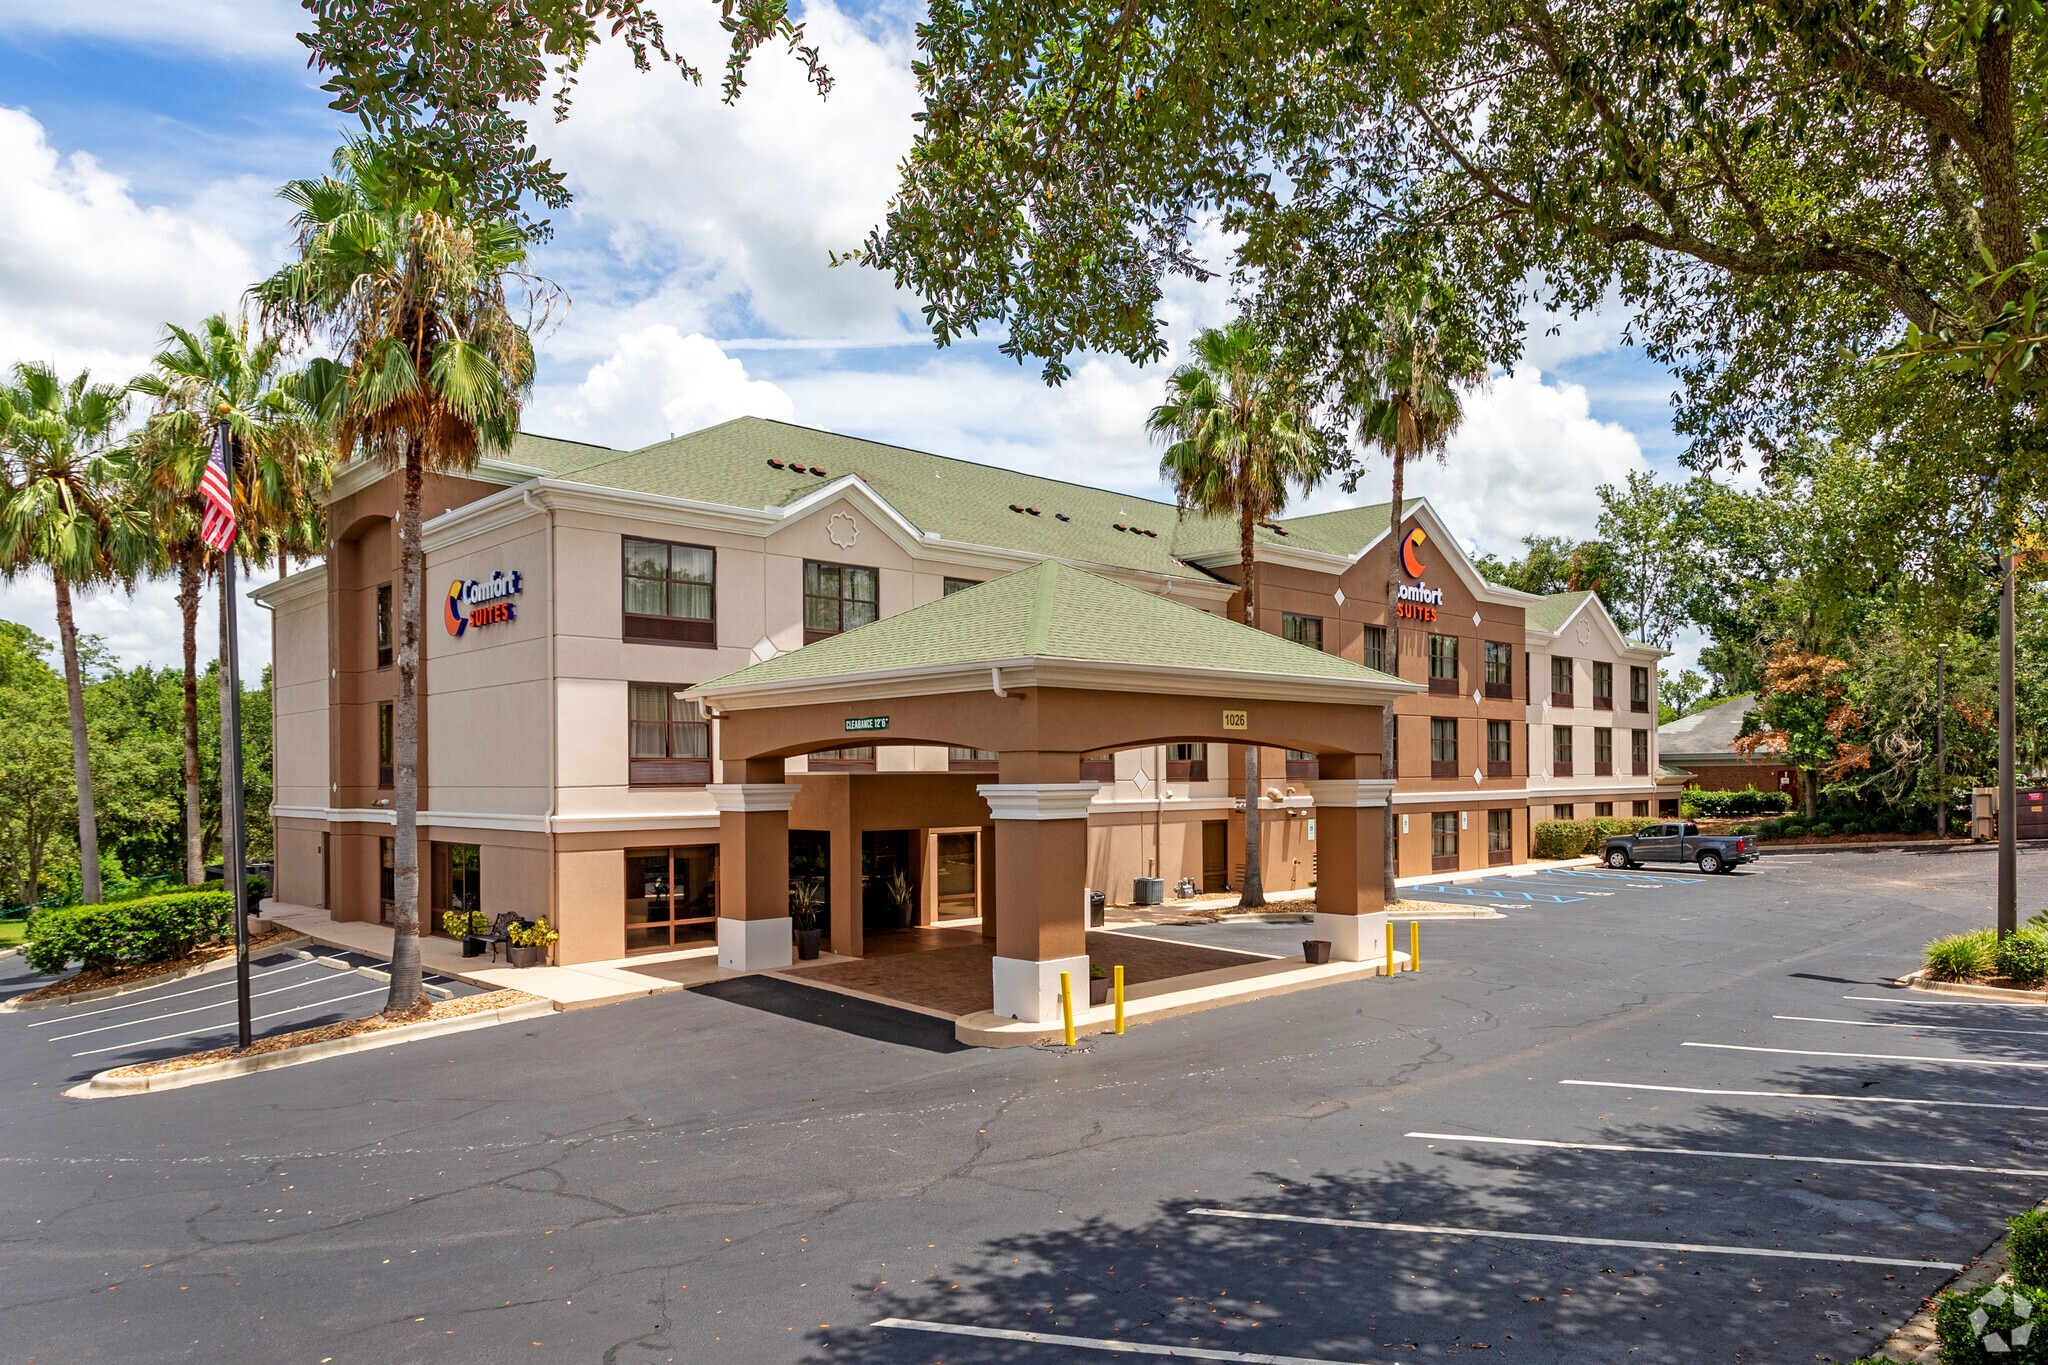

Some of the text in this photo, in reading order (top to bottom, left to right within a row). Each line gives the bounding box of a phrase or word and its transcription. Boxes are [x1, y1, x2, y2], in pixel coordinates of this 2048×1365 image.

[462, 570, 519, 605] Comfort
[469, 602, 511, 628] SUITES
[1397, 603, 1437, 621] SUITES
[846, 719, 873, 730] CLEARANCE
[1225, 714, 1245, 726] 1026
